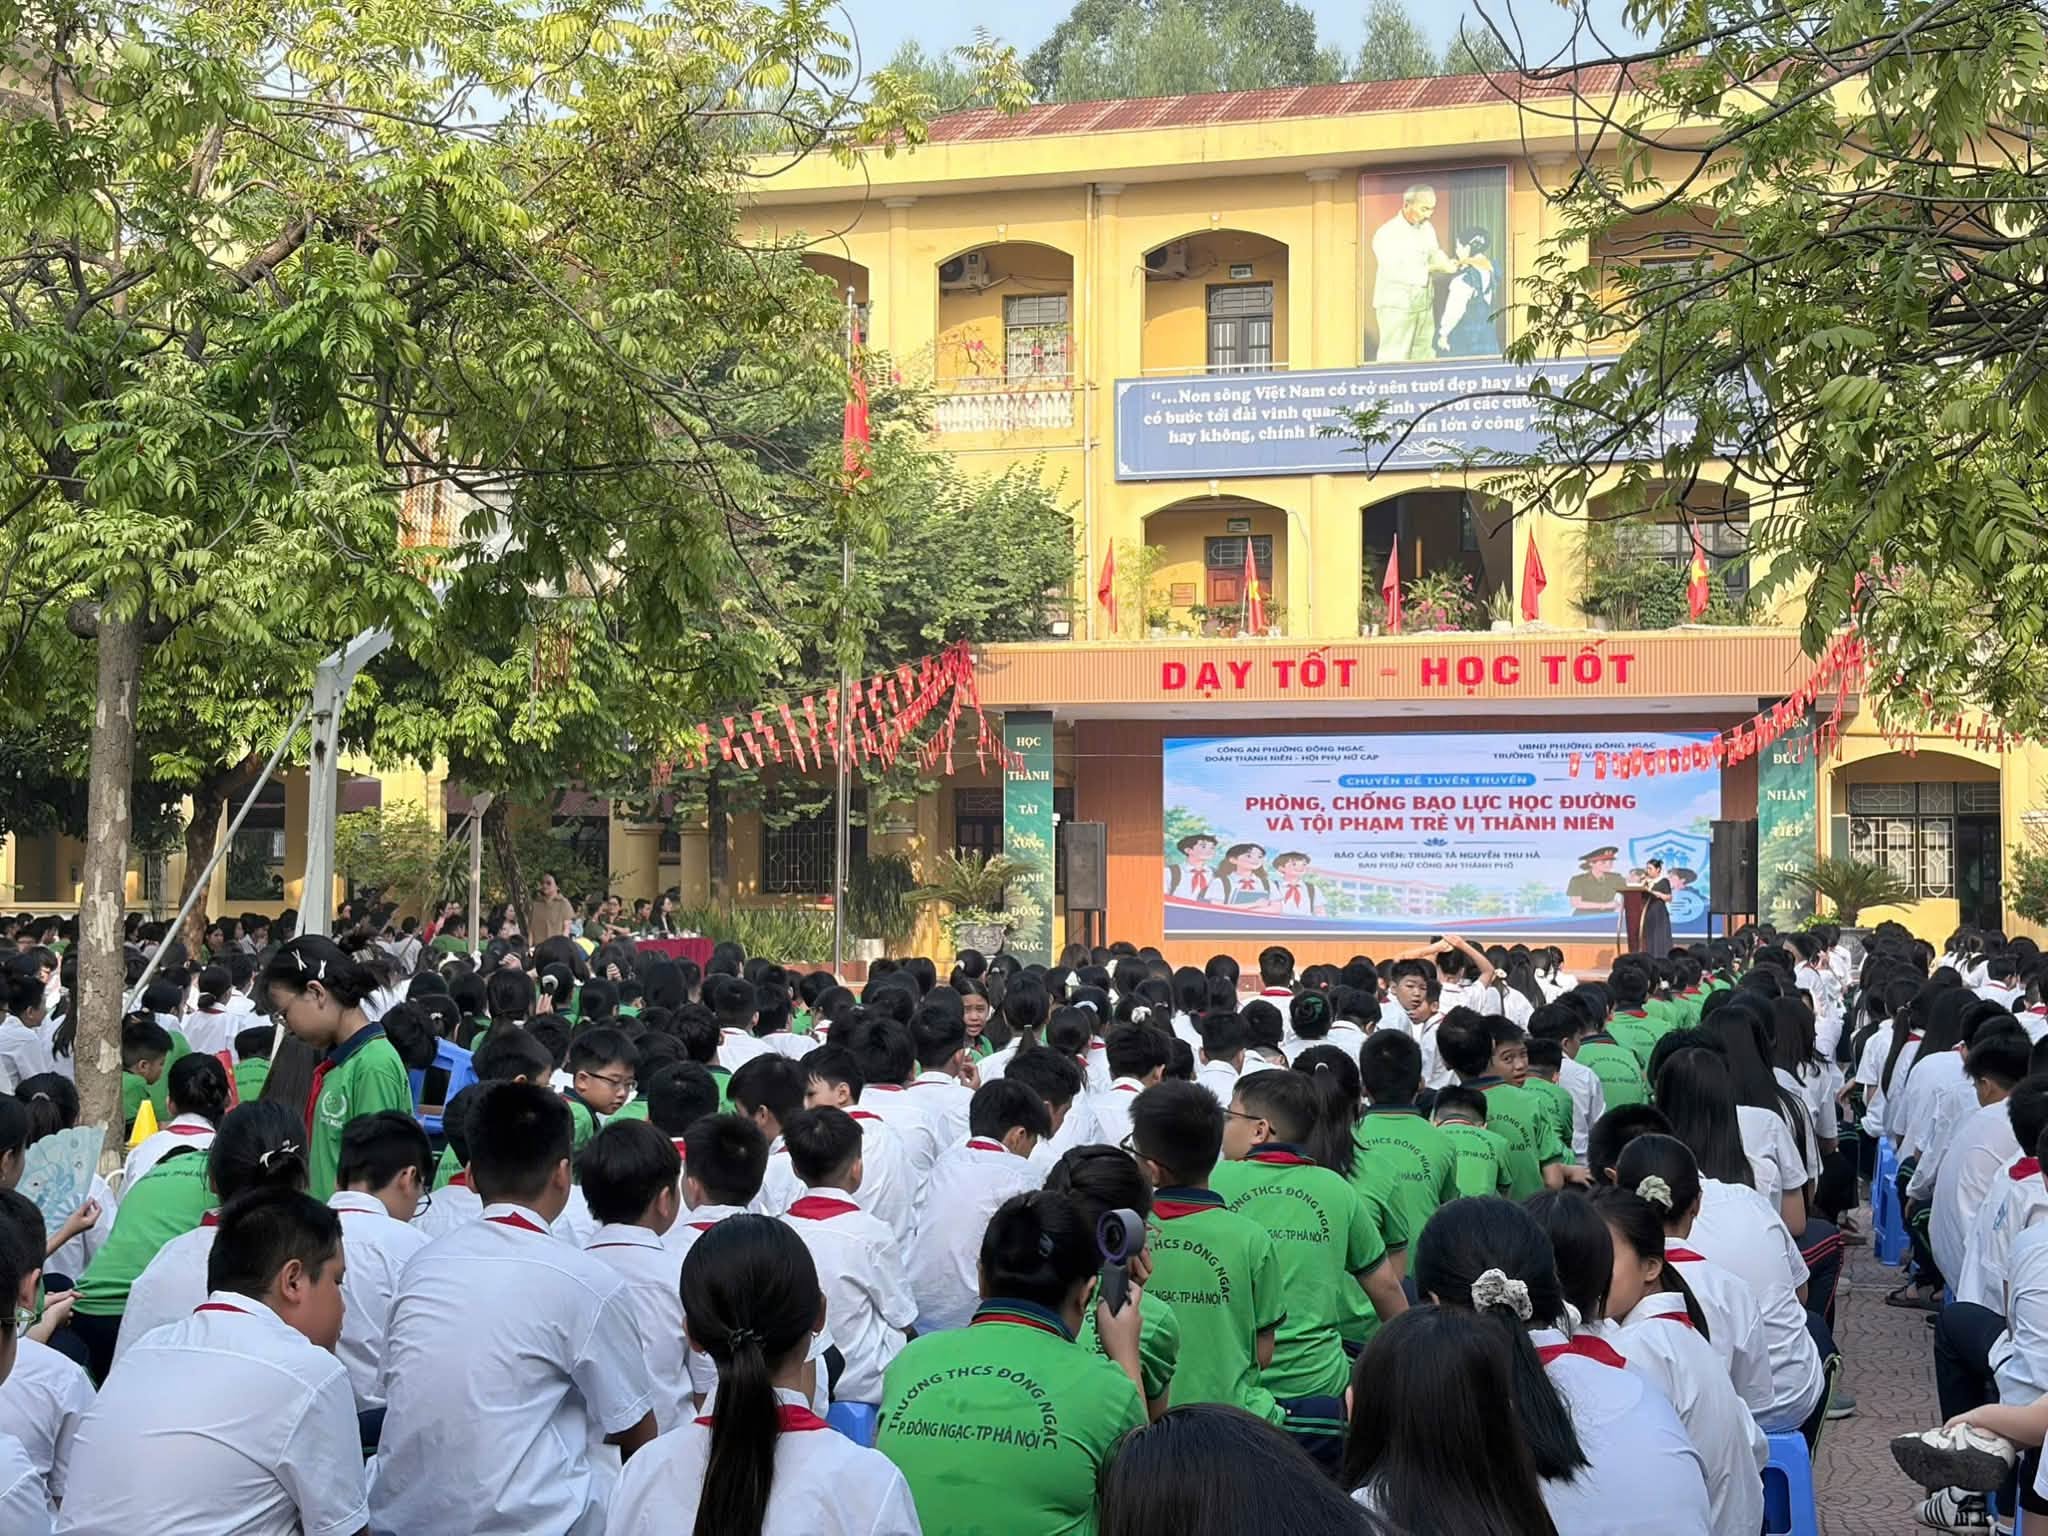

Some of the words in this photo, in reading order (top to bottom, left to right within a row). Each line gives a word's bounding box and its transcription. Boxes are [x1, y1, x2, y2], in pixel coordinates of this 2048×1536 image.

[1213, 387, 1250, 404] sông
[1254, 385, 1286, 403] Việt
[1289, 385, 1325, 399] Nam
[1328, 381, 1347, 396] có
[1349, 379, 1376, 396] trở
[1378, 377, 1408, 395] nên
[1447, 375, 1477, 396] đẹp
[1482, 376, 1511, 392] hay
[1144, 410, 1162, 425] có
[1166, 409, 1202, 424] bước
[1207, 407, 1230, 422] tới
[1232, 406, 1257, 422] đài
[1261, 405, 1298, 421] vinh
[1472, 395, 1499, 411] các
[1168, 429, 1196, 446] hay
[1200, 427, 1255, 444] không,
[1258, 424, 1305, 441] chính
[1440, 415, 1466, 433] lớn
[1485, 415, 1525, 432] công
[1161, 659, 1253, 699] DẠY
[1271, 645, 1358, 689] TỐT
[1420, 653, 1521, 696] HỌC
[1540, 637, 1635, 685] TỐT
[1016, 736, 1041, 749] HỌC
[1217, 745, 1244, 753] CÔNG
[1246, 745, 1260, 753] AN
[1008, 768, 1050, 781] THÀNH
[1346, 775, 1400, 786] CHUYÊN
[1426, 774, 1471, 785] TUYÊN
[1245, 793, 1326, 813] PHÒNG,
[1332, 791, 1406, 811] CHỐNG
[1412, 796, 1456, 813] BẠO
[1463, 794, 1501, 813] LỰC
[1508, 795, 1553, 813] HỌC
[1559, 791, 1636, 810] ĐƯỜNG
[1266, 813, 1294, 831] VÀ
[1300, 813, 1333, 834] TỘI
[1339, 817, 1405, 834] PHẠM
[1410, 812, 1449, 831] TRẺ
[1454, 816, 1475, 834] VỊ
[1481, 812, 1556, 831] THÀNH
[1563, 812, 1614, 831] NIÊN
[1775, 859, 1799, 873] NỐI
[1011, 941, 1044, 953] NGẠC
[1250, 1185, 1282, 1197] THCS
[1149, 1239, 1180, 1253] HCS
[946, 1365, 994, 1380] THCS
[1014, 1429, 1041, 1452] NỘI
